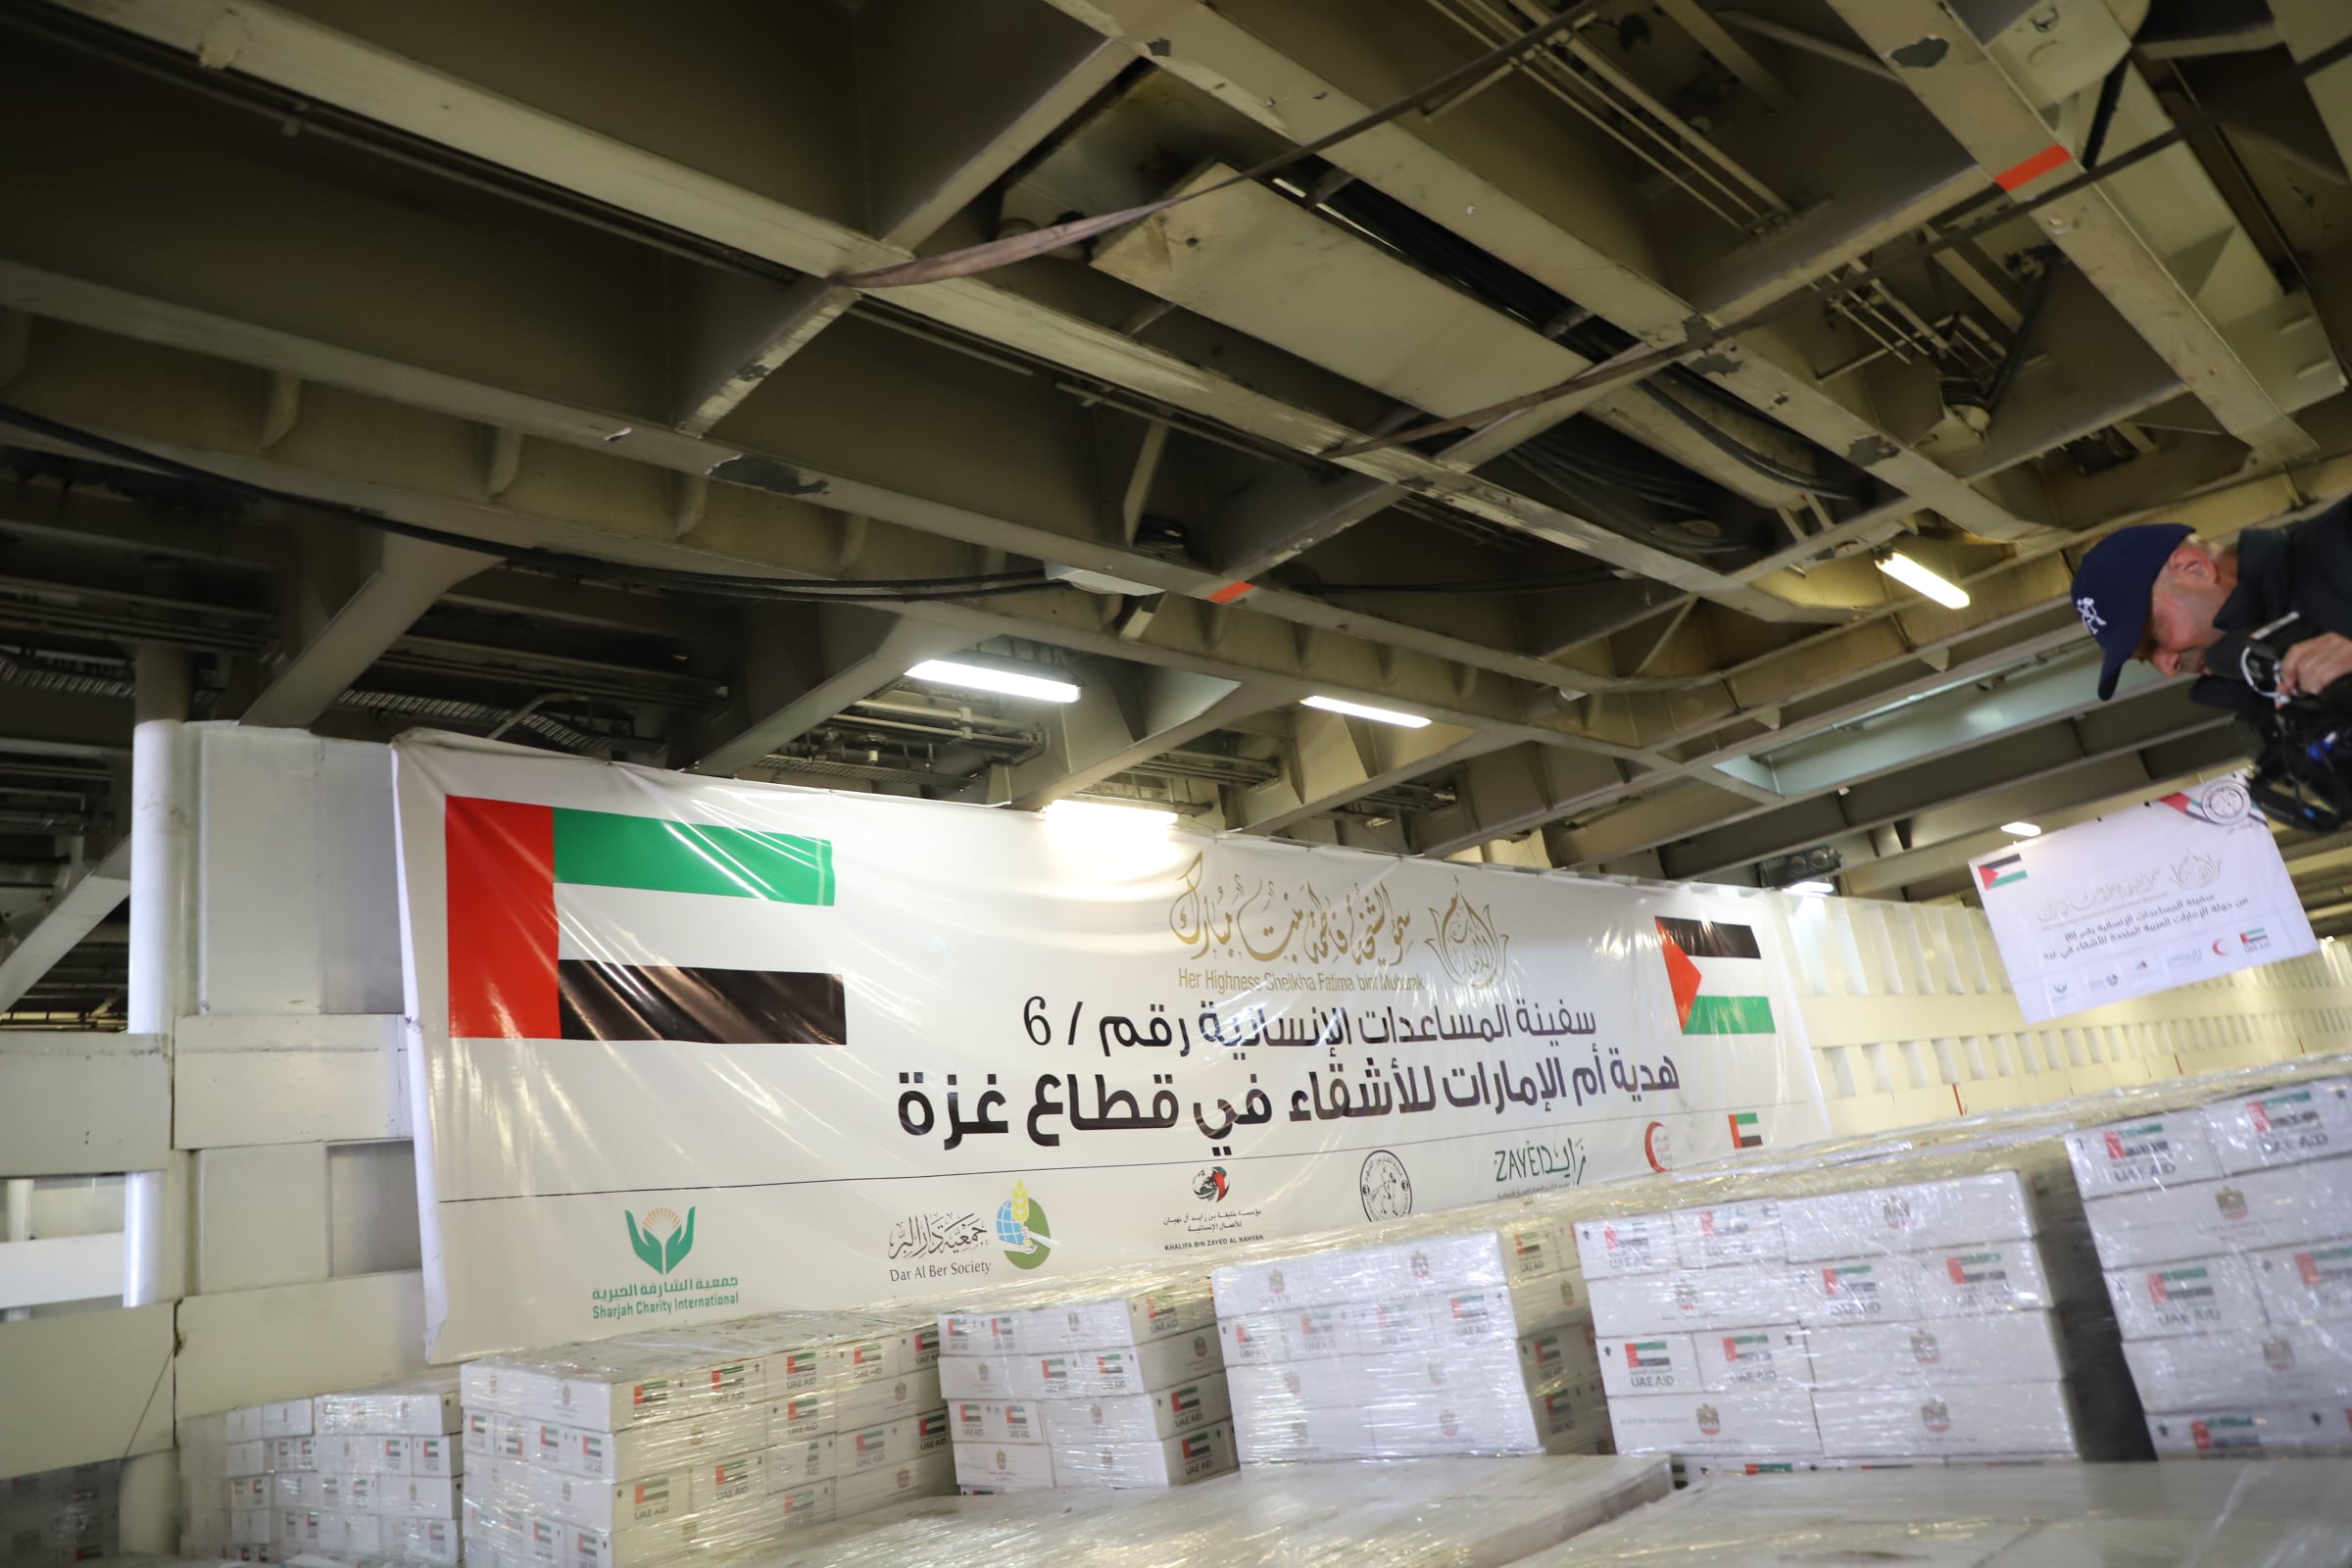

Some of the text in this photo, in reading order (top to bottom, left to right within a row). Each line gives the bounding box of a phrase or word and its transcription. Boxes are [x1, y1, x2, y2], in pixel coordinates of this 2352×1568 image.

[1178, 967, 1200, 990] Her
[1204, 969, 1261, 995] Highness
[1264, 971, 1316, 992] Sheikha
[1319, 973, 1354, 992] Fatima
[1023, 995, 1052, 1046] 6
[1099, 1004, 1191, 1057] رقم
[1198, 1000, 1352, 1061] الإنسانية
[1359, 1004, 1511, 1046] المساعدات
[1515, 998, 1596, 1048] سفينة
[898, 1043, 1680, 1157] هدية أم الإمارات للأشقاء في قطاع غزة
[1164, 1234, 1264, 1251] KHALIFA BIN ZAYED AL NAHYAN
[890, 1260, 992, 1282] Dar Al Ber Society
[592, 1276, 739, 1302] جمعية الشارقة الخيرية
[592, 1292, 739, 1320] Sharjah Charity International
[1151, 1320, 1179, 1334] UAE AID
[787, 1377, 816, 1390] UAE AID
[1631, 1374, 1676, 1388] UAE AID
[1175, 1412, 1203, 1428] UAE AID
[920, 1438, 948, 1450] UAE AID
[1186, 1459, 1213, 1475] UAE AID
[635, 1504, 669, 1519] UAE AID
